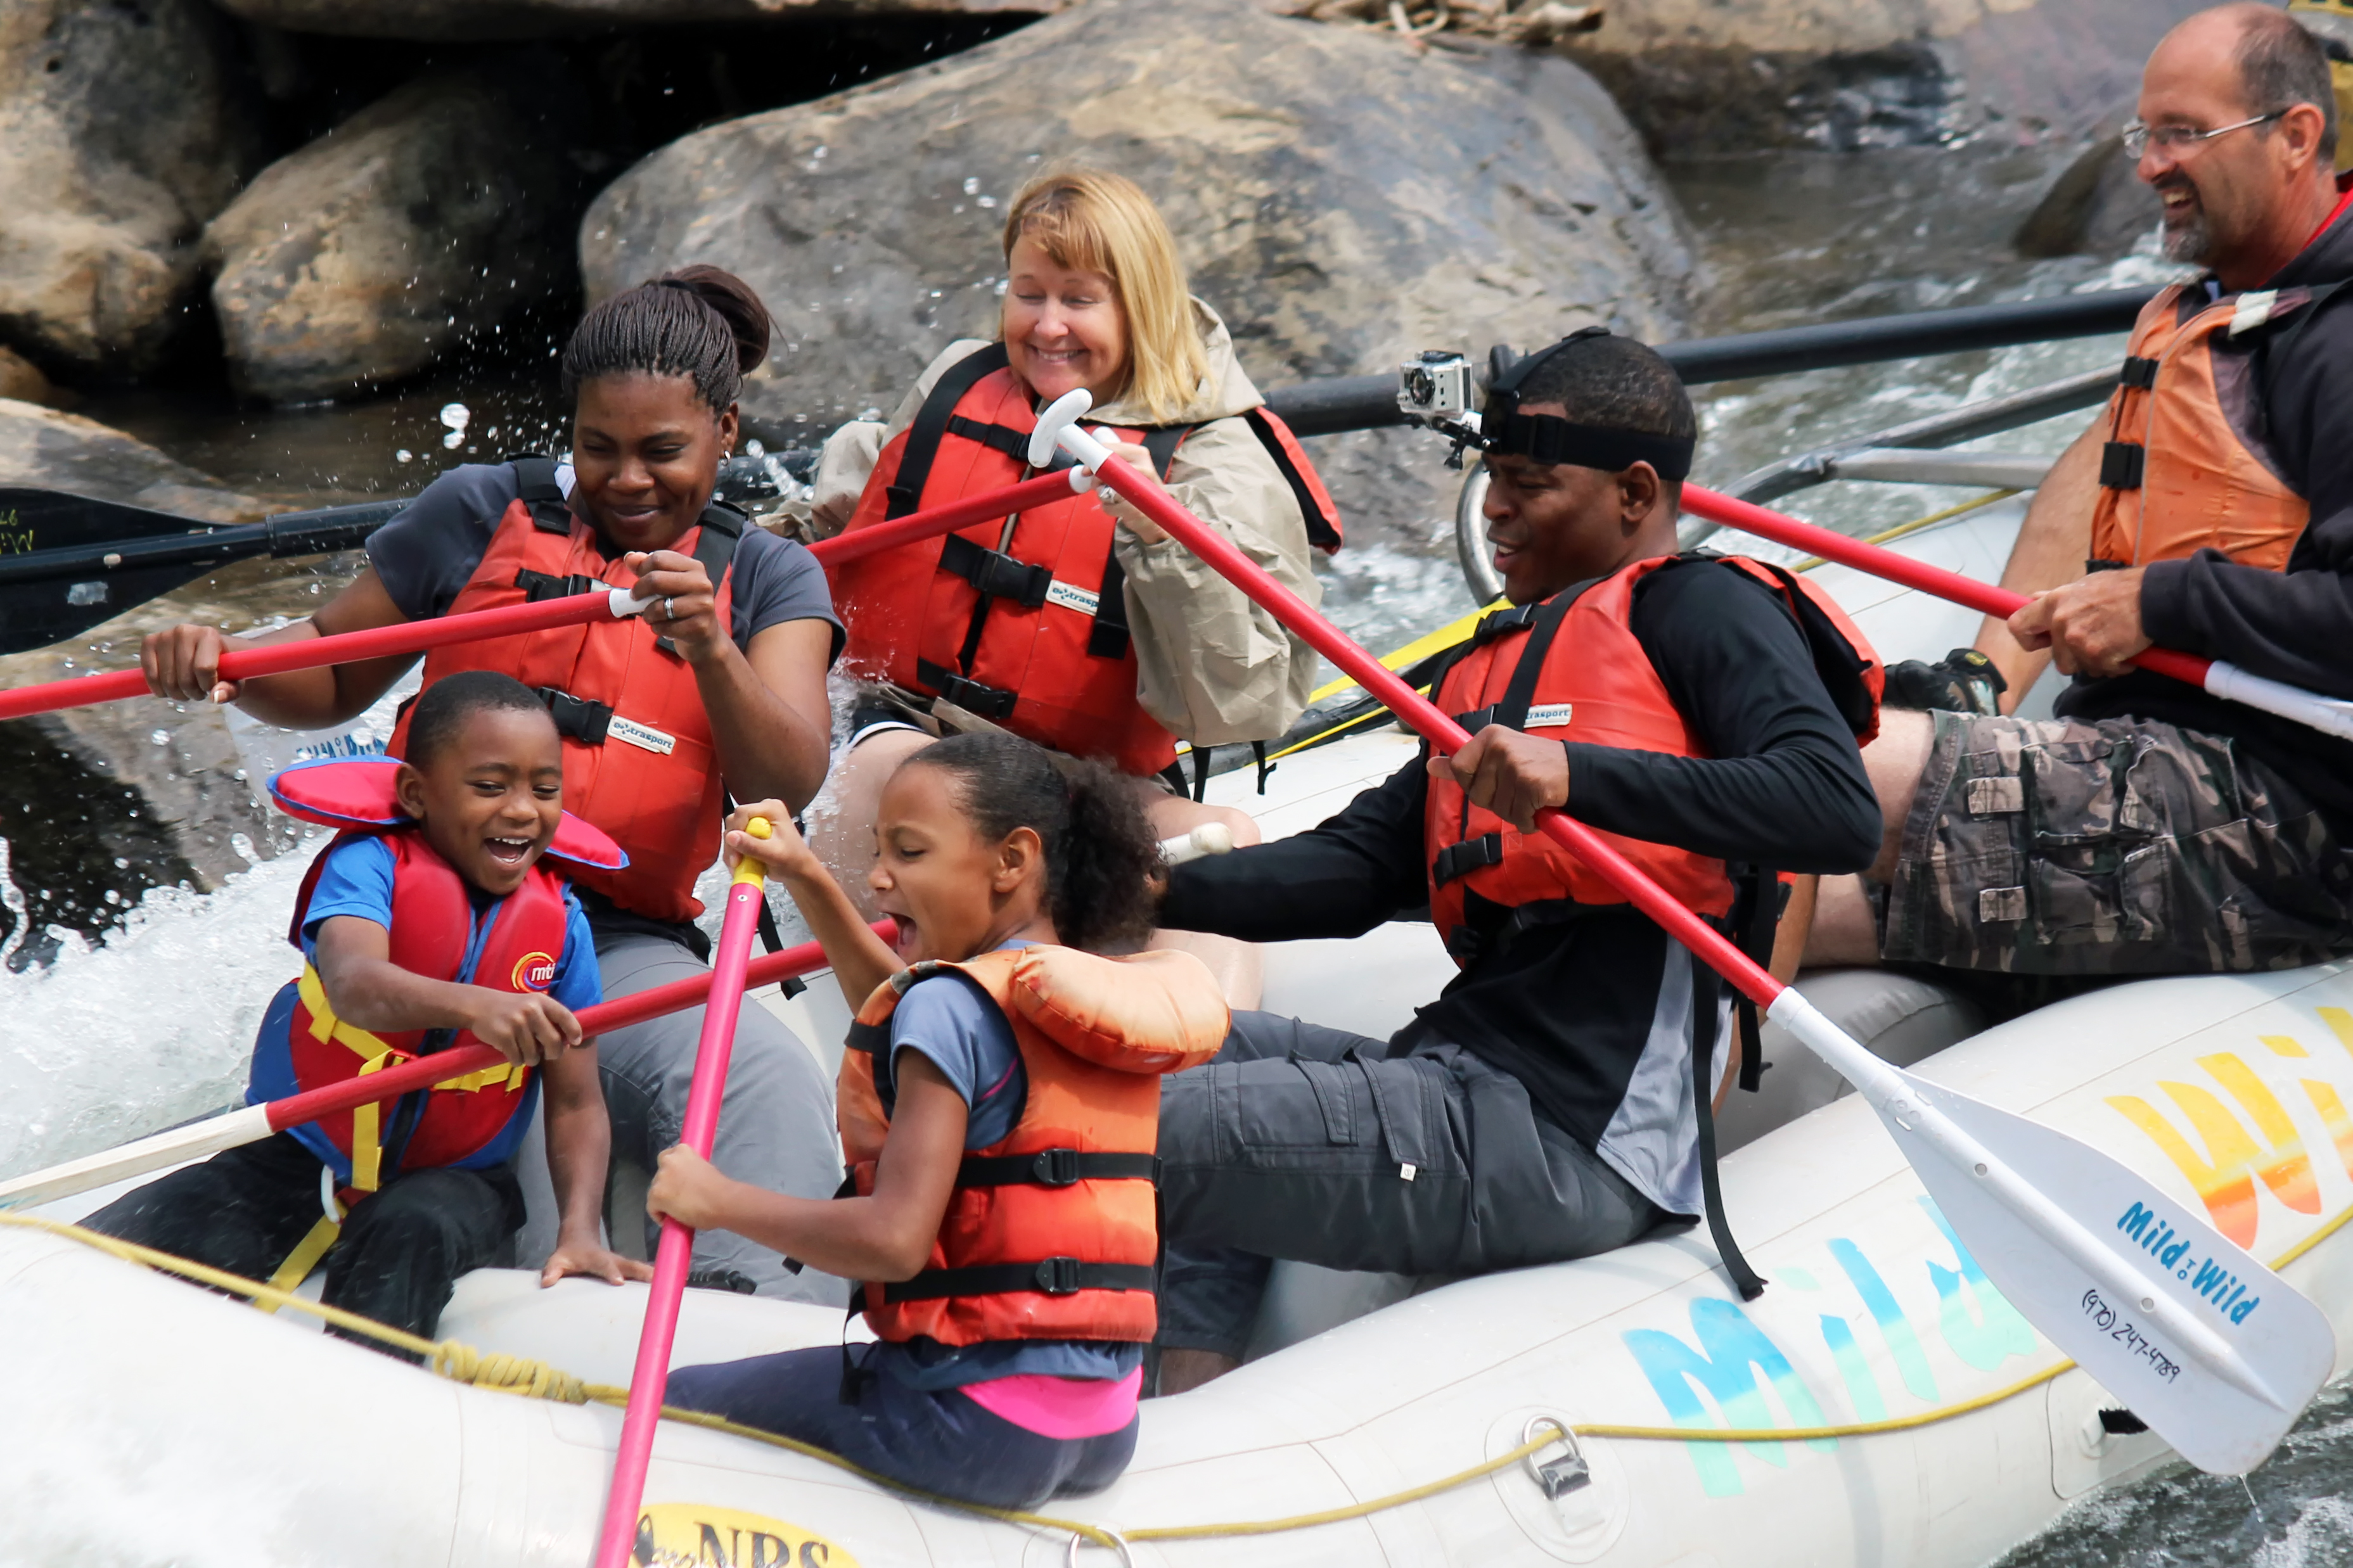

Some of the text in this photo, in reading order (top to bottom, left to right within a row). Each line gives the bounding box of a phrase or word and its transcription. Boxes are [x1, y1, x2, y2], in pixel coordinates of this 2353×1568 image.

[1053, 588, 1099, 607] extrasp
[2117, 1201, 2190, 1270] Mild
[2192, 1258, 2260, 1325] Wild
[1620, 1195, 2037, 1497] Mild
[2082, 1289, 2180, 1384] (970) 247-4789
